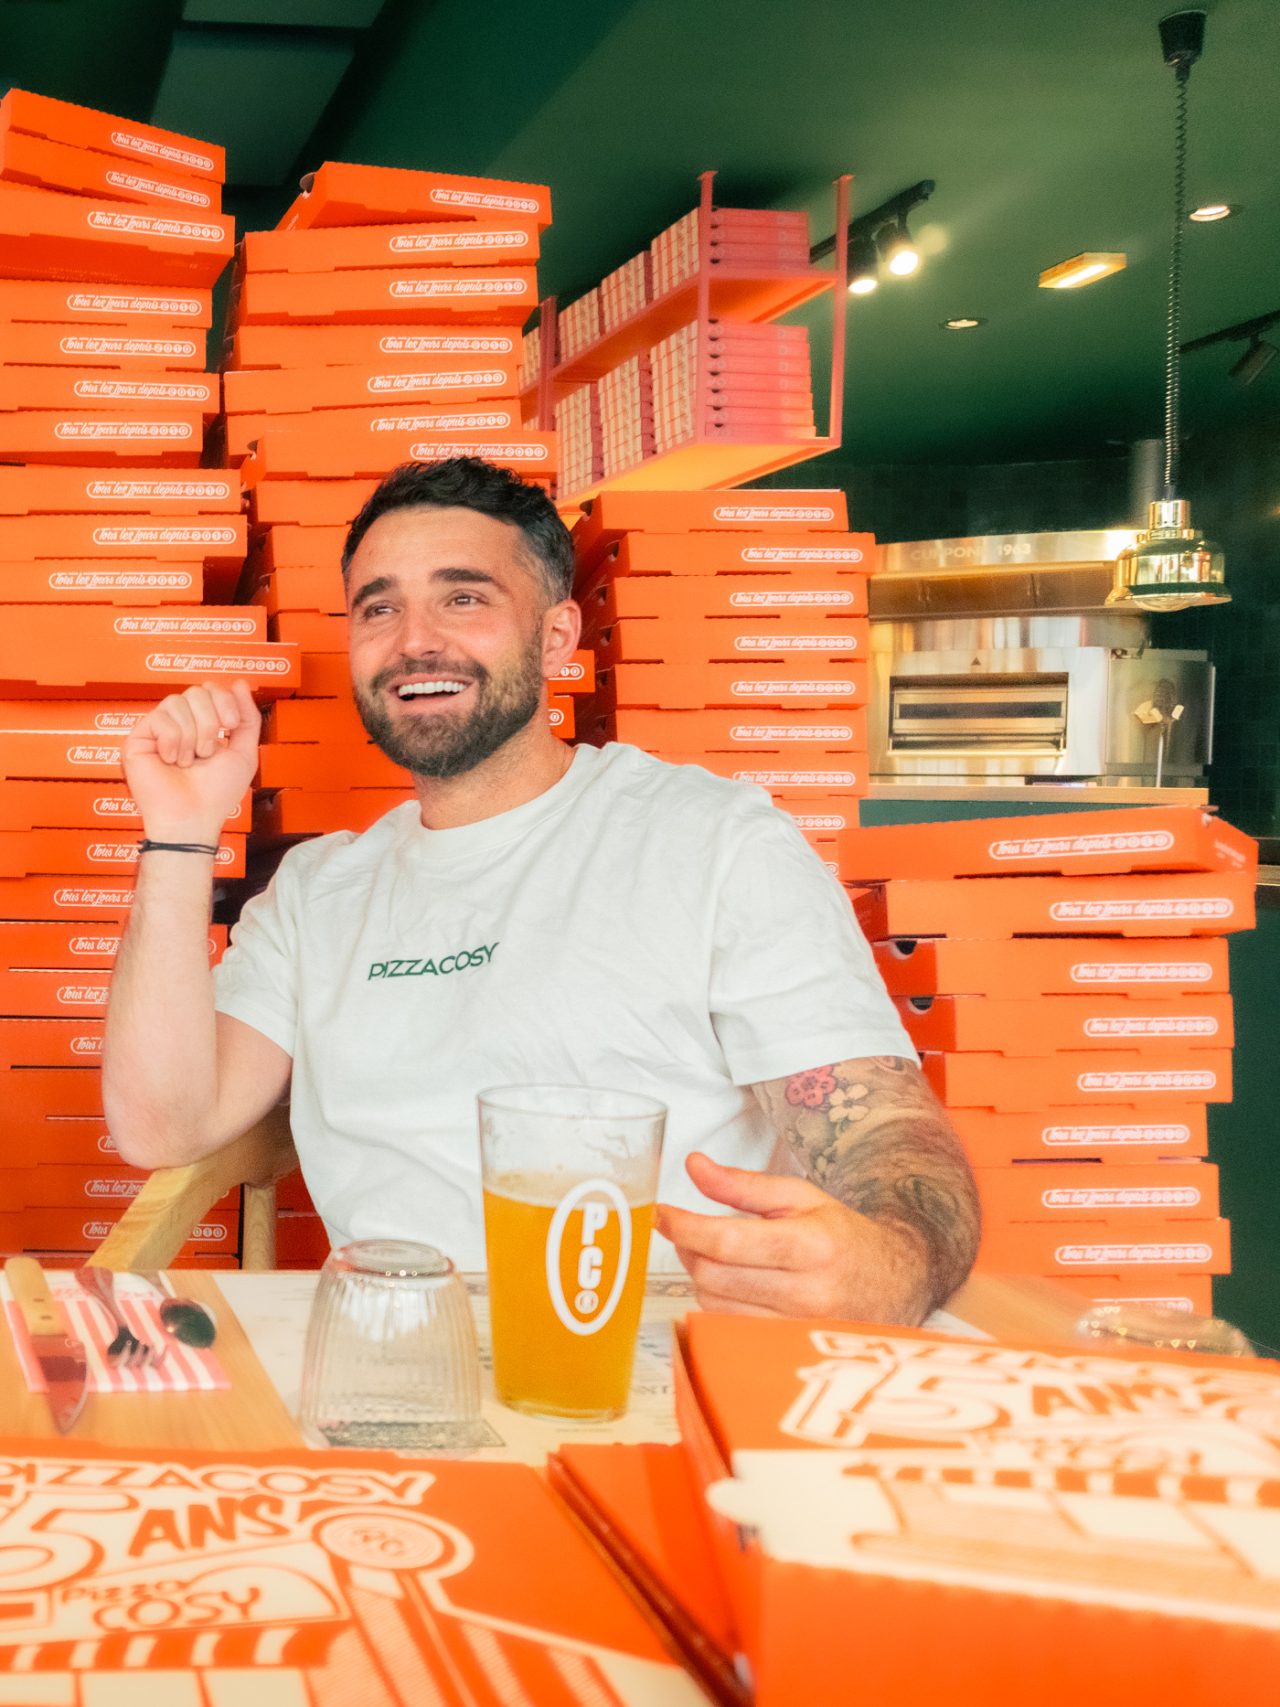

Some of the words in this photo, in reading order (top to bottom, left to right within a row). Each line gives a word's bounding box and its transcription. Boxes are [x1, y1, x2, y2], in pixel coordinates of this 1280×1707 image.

[93, 212, 110, 225] Tous
[151, 219, 181, 235] depuis
[395, 237, 412, 248] Tous
[454, 234, 484, 248] depuis
[395, 281, 413, 293] Tous
[454, 280, 484, 294] depuis
[72, 295, 89, 306] Tous
[130, 297, 159, 312] depuis
[65, 338, 83, 349] Tous
[123, 339, 153, 354] depuis
[385, 337, 402, 348] Tous
[441, 338, 470, 351] depuis
[373, 376, 391, 388] Tous
[432, 373, 463, 387] depuis
[80, 381, 97, 393] Tous
[137, 383, 167, 398] depuis
[60, 423, 78, 434] Tous
[118, 423, 149, 437] depuis
[92, 482, 110, 494] Tous
[153, 482, 184, 497] depuis
[99, 527, 117, 540] Tous
[159, 528, 191, 543] depuis
[55, 572, 73, 584] Tous
[115, 572, 146, 587] depuis
[120, 618, 137, 630] Tous
[180, 618, 211, 633] depuis
[152, 654, 170, 667] Tous
[213, 656, 245, 672] depuis
[60, 889, 79, 902] Tous
[368, 941, 500, 980] PIZZACOSY
[128, 1494, 291, 1557] ANS
[92, 1586, 262, 1634] COSY
